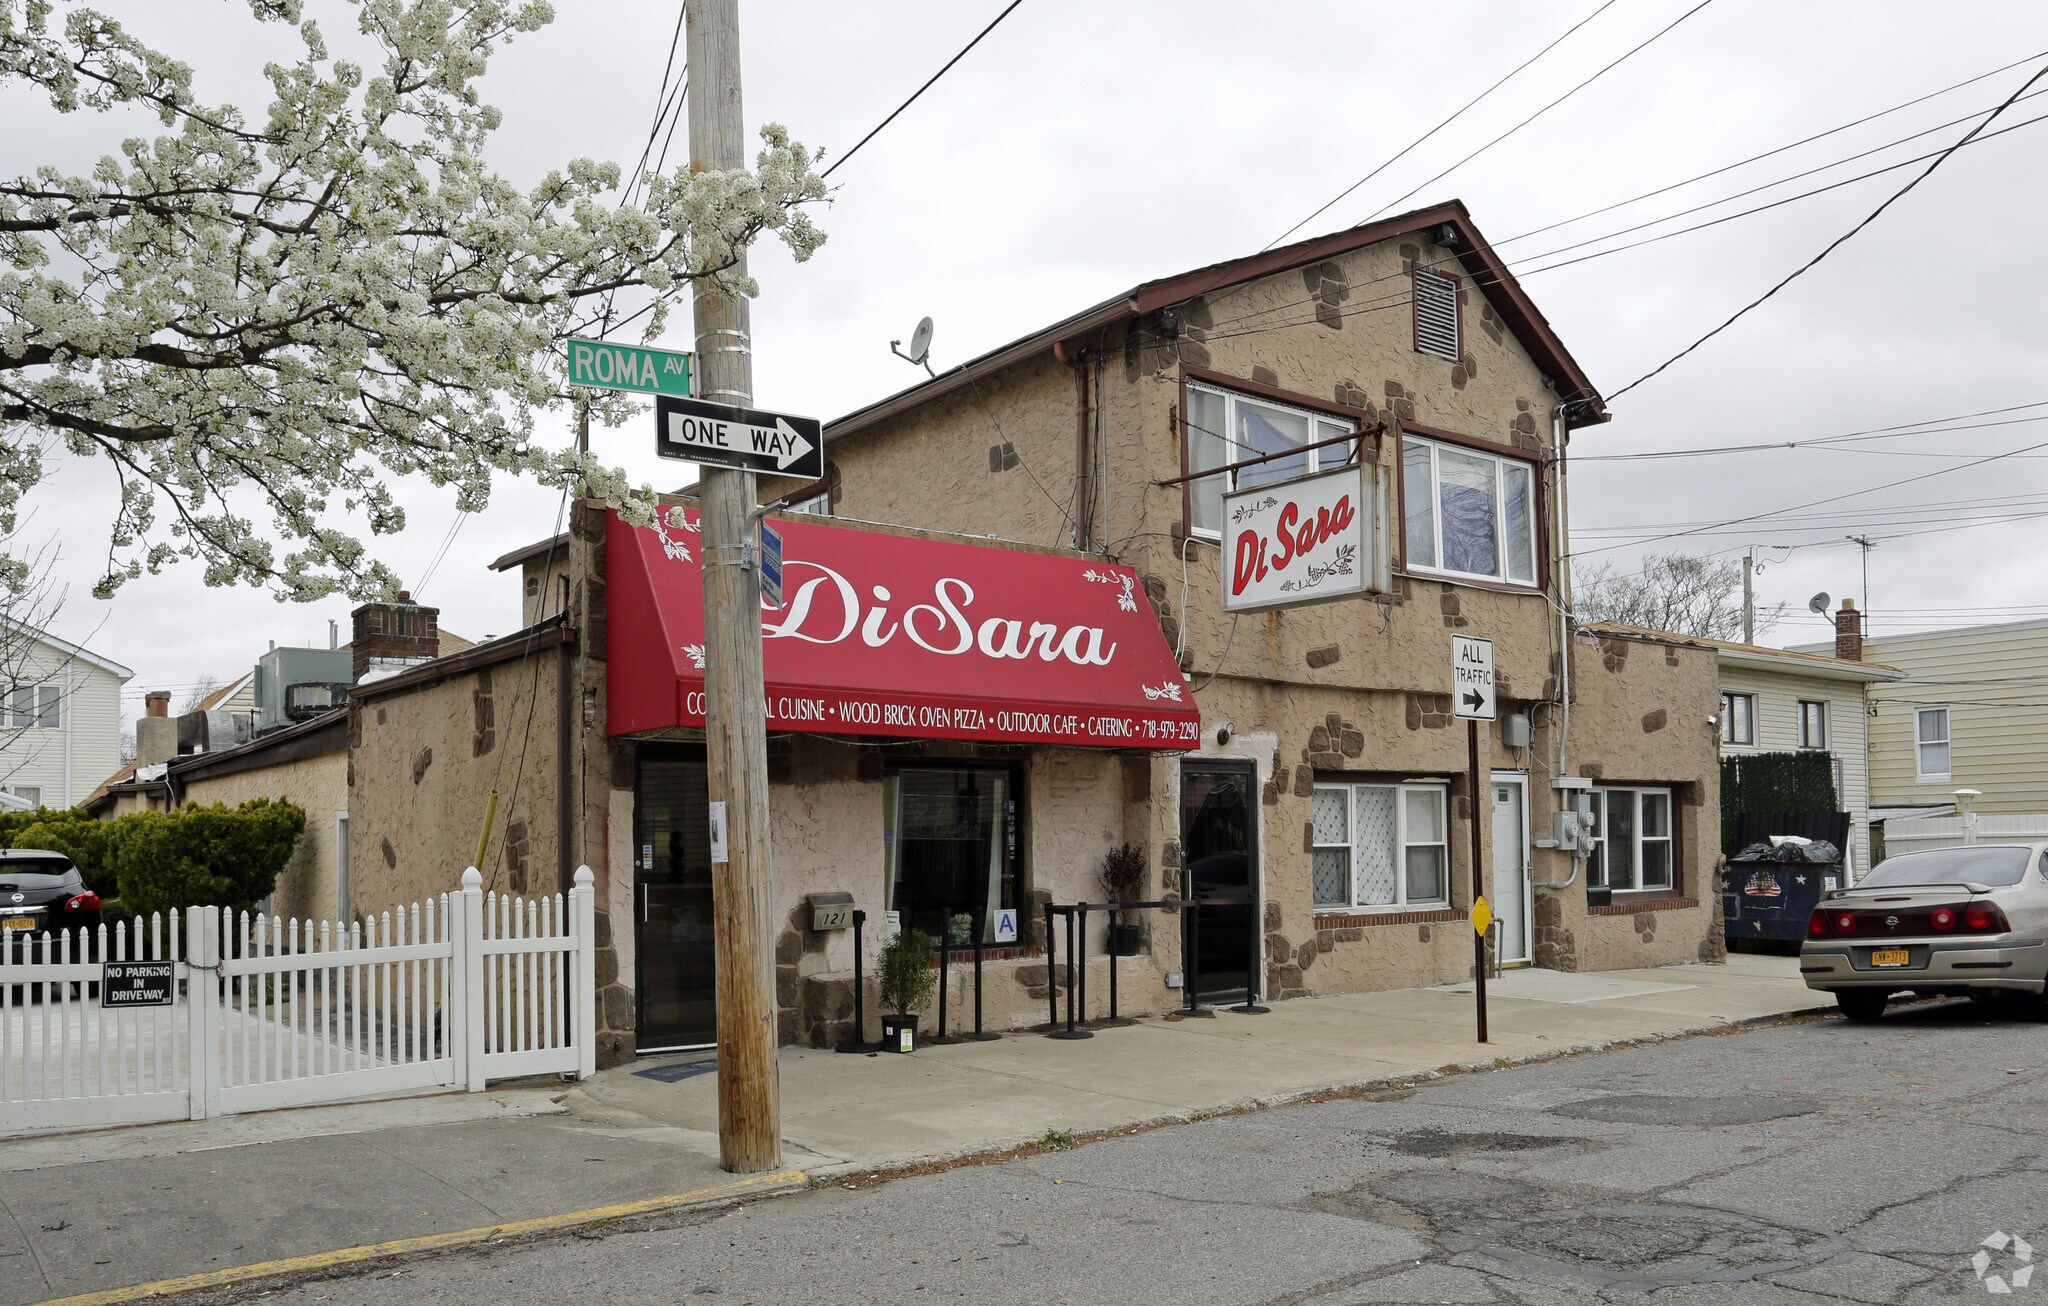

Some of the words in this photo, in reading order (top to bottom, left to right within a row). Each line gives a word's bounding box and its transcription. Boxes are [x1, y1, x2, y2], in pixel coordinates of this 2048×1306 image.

[575, 345, 659, 388] ROMA
[664, 357, 685, 375] AV
[682, 418, 728, 447] ONE
[751, 429, 797, 456] WAY
[690, 455, 728, 463] TRANSPORTATION
[1232, 529, 1269, 596] Di
[1271, 494, 1355, 571] Sara
[760, 560, 899, 648] Di
[903, 577, 1117, 666] Sara
[1462, 643, 1484, 664] ALL
[1456, 667, 1491, 685] TRAFFIC
[779, 697, 825, 721] CUISINE
[839, 701, 881, 724] WOOD
[884, 704, 916, 726] BRICK
[919, 706, 951, 728] OVEN
[954, 708, 985, 730] PIZZA
[997, 711, 1051, 733] OUTDOOR
[1054, 715, 1077, 735] CAFE
[1088, 717, 1132, 737] CATERING
[1142, 720, 1198, 740] 718-979-2290
[824, 912, 846, 924] 121
[999, 913, 1014, 933] A
[107, 967, 122, 978] NO
[126, 966, 170, 978] PARKING
[133, 978, 144, 988] IN
[112, 989, 164, 1001] DRIVEWAY
